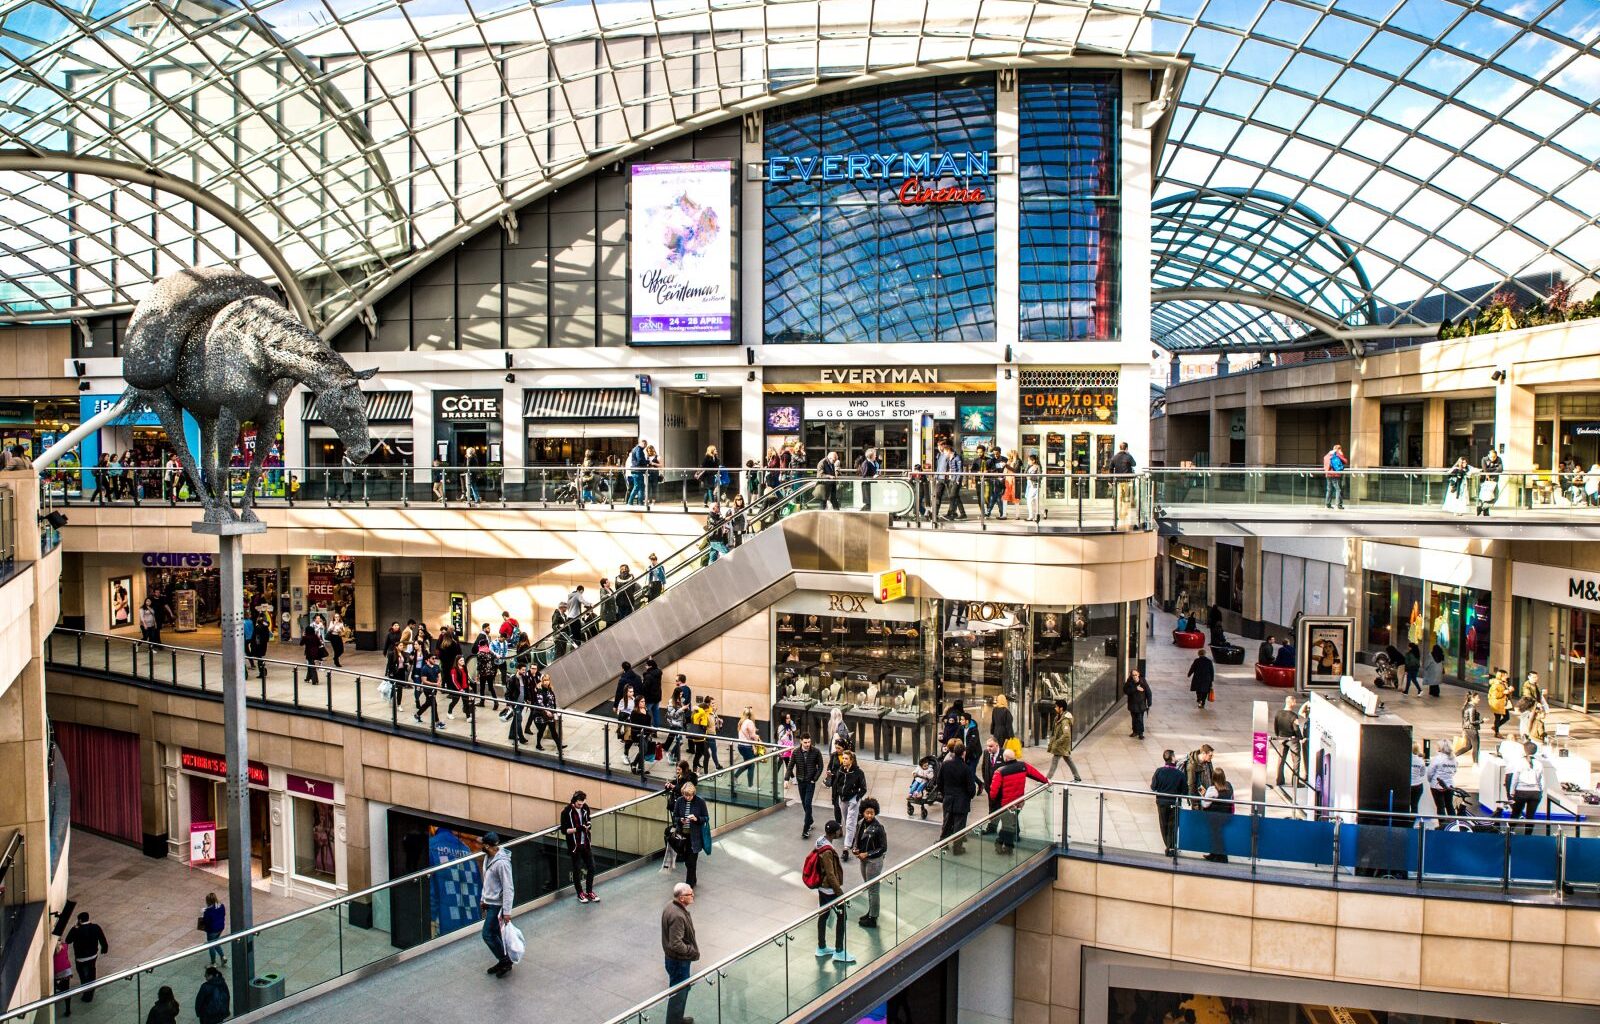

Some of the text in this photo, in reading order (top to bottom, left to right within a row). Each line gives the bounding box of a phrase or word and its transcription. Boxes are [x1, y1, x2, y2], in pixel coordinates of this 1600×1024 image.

[769, 151, 989, 182] EVERYMAN
[900, 178, 986, 205] Cinema
[642, 269, 677, 293] Officer
[657, 280, 720, 305] Gentleman
[669, 317, 680, 325] 24
[687, 317, 698, 325] 28
[700, 316, 723, 325] APRIL
[820, 368, 938, 383] EVERYMAN
[442, 395, 497, 412] CÔTE
[1024, 394, 1114, 407] COMPTOIR
[308, 585, 334, 595] FREE
[1569, 578, 1600, 601] M&
[827, 593, 867, 613] ROX
[967, 600, 1007, 622] ROX
[182, 753, 219, 772] VICTORIA'S
